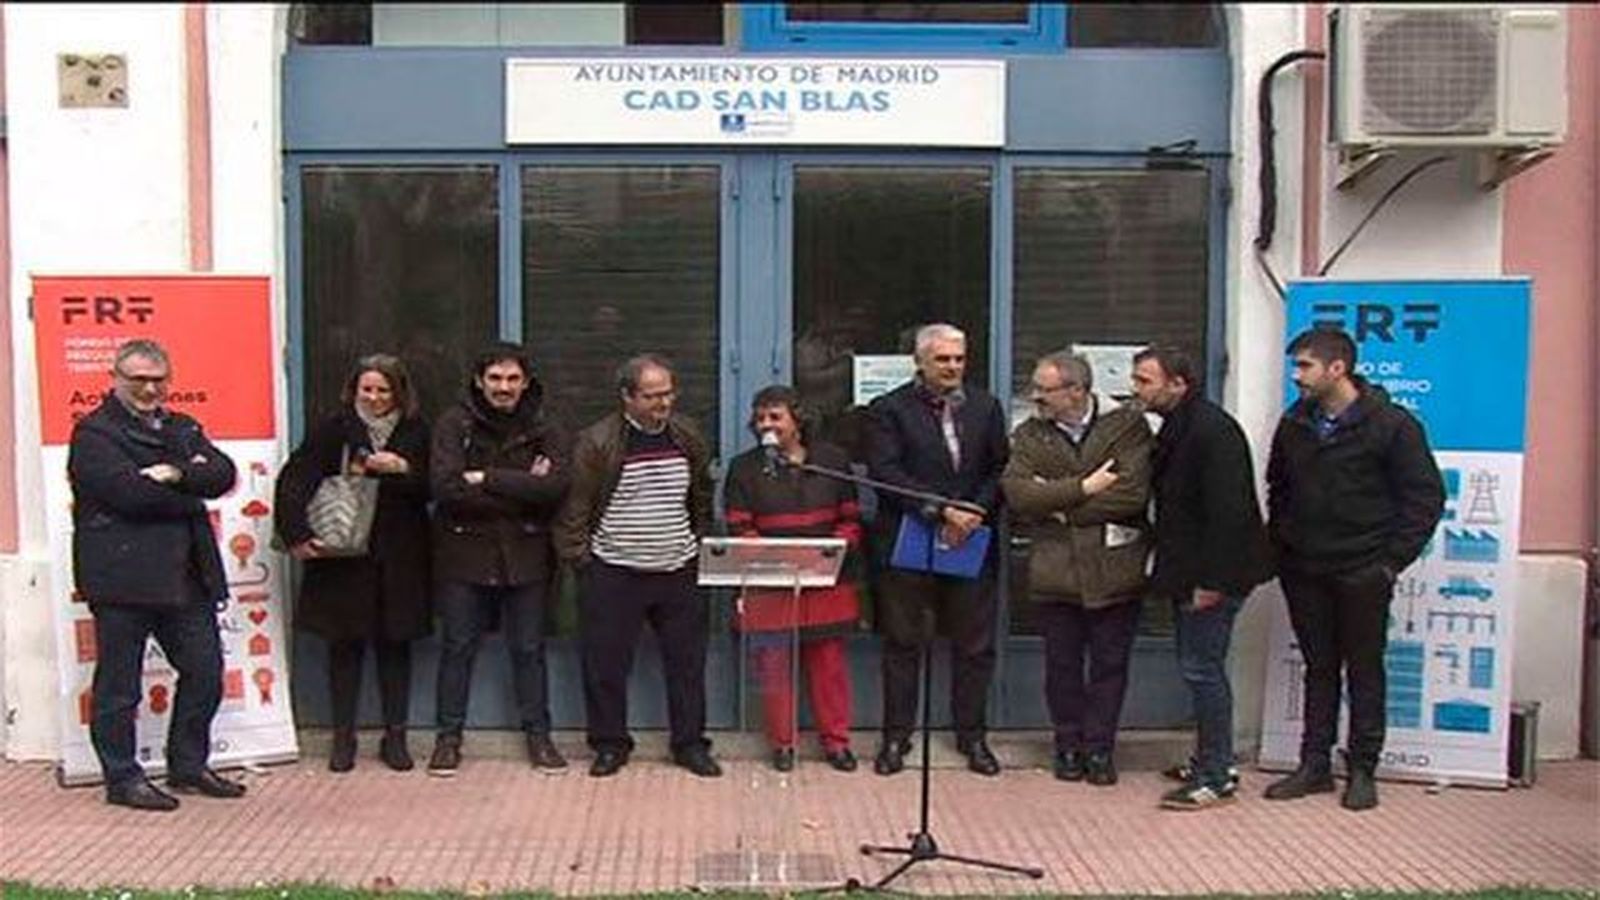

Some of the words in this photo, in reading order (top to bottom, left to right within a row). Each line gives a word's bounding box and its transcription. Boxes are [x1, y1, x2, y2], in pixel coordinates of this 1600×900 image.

[575, 65, 778, 82] AYUNTAMIENTO
[790, 66, 823, 83] DE
[837, 66, 939, 84] MADRID
[624, 90, 700, 110] CAD
[712, 90, 787, 111] SAN
[801, 90, 890, 111] BLAS
[61, 297, 153, 324] FRT
